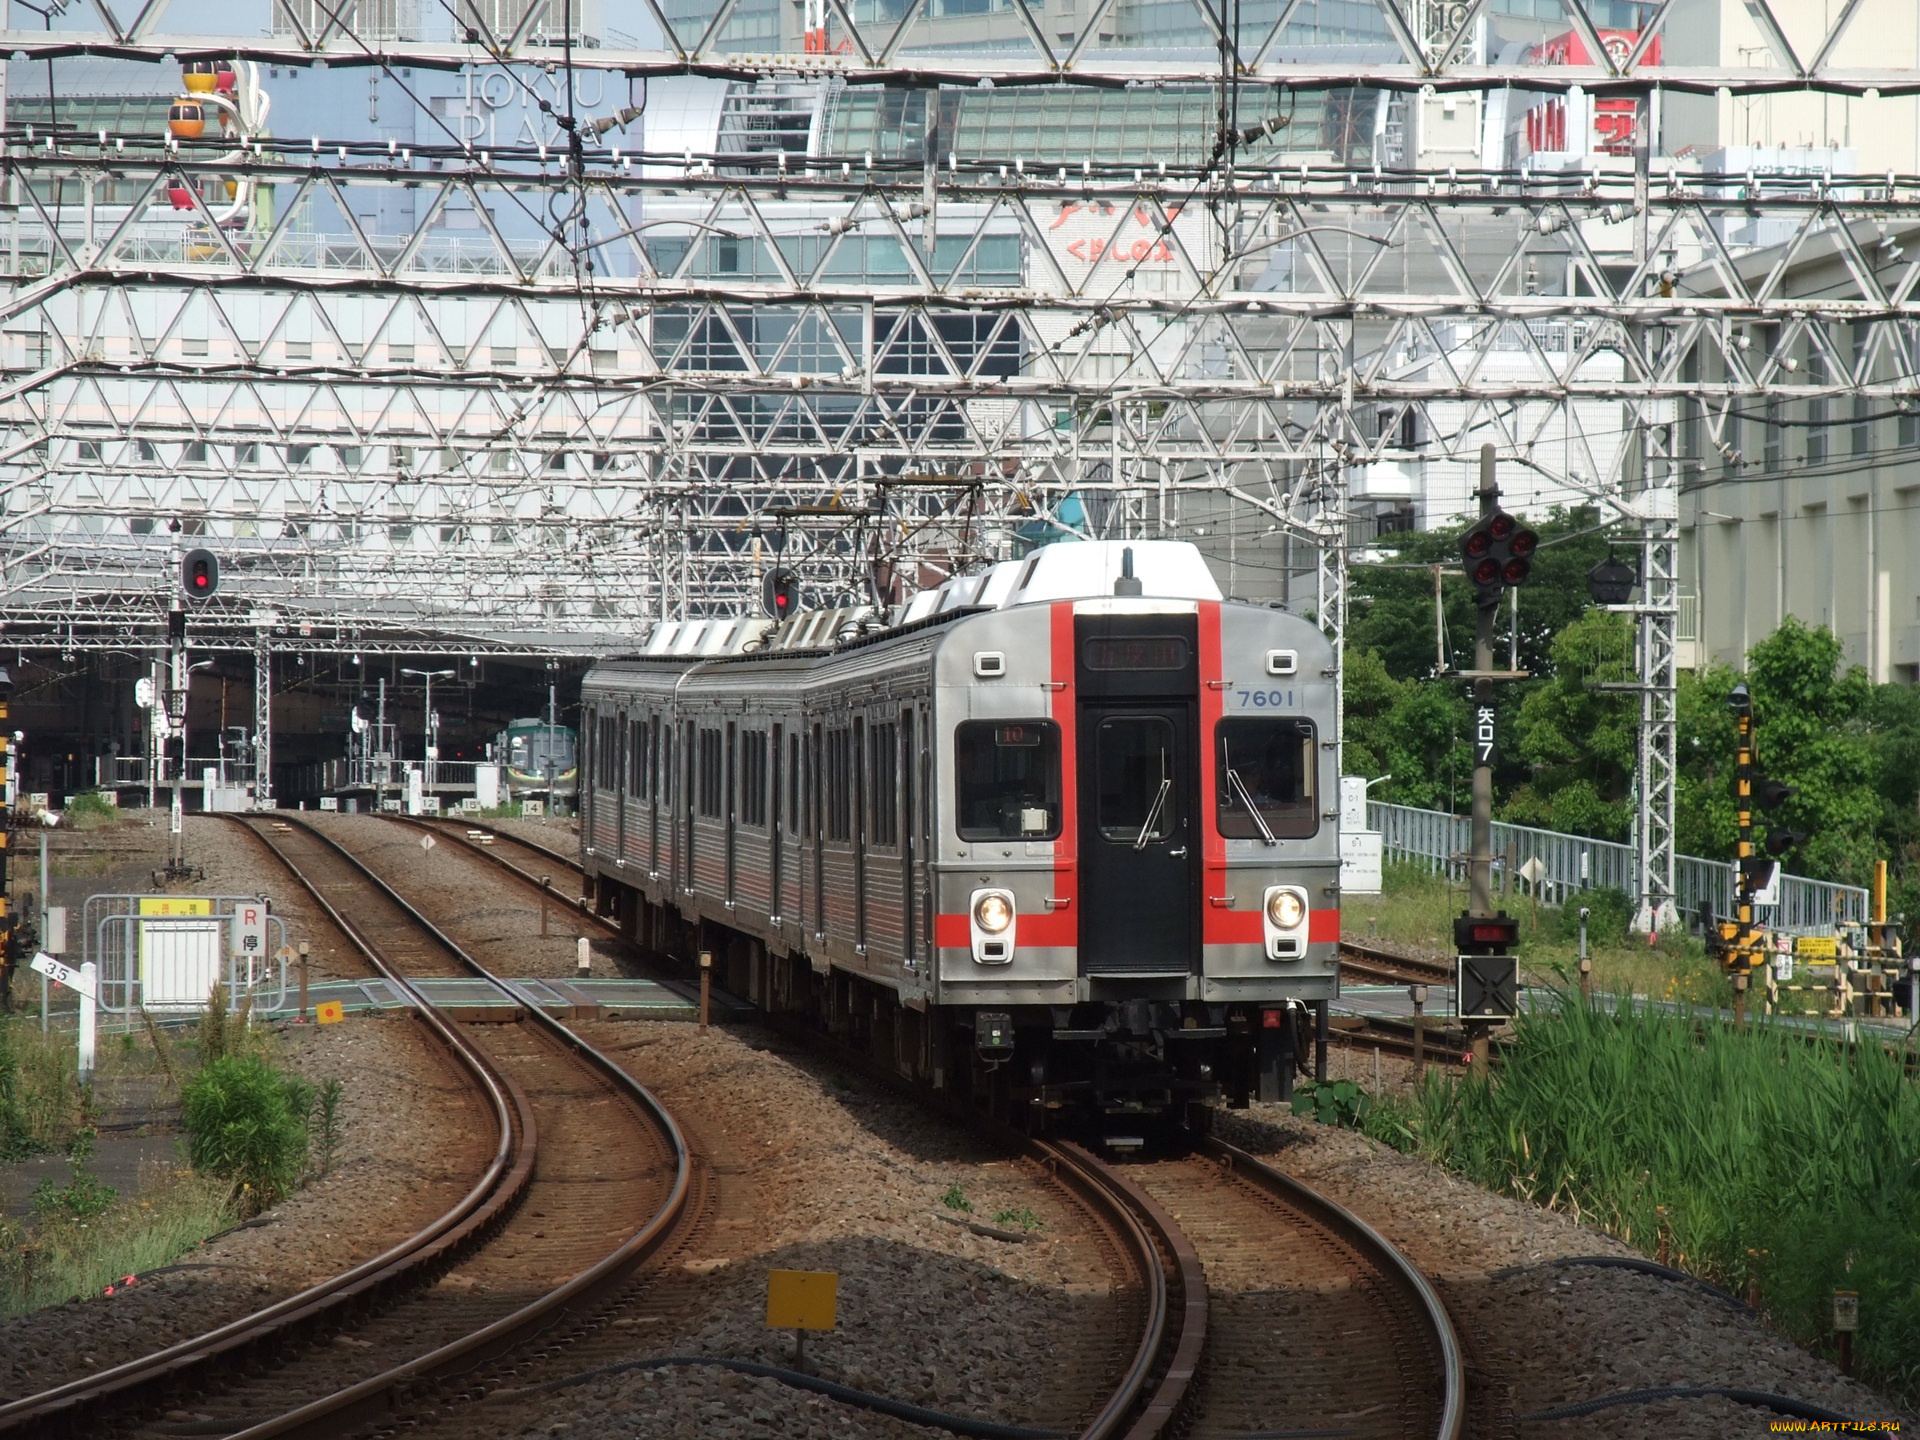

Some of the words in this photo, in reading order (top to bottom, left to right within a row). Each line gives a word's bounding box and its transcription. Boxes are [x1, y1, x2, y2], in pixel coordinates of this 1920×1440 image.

[455, 72, 603, 109] TOKYU
[1237, 690, 1293, 707] 7601
[525, 803, 538, 812] 14
[244, 909, 257, 925] R
[243, 935, 258, 951] 停
[45, 962, 69, 981] 35
